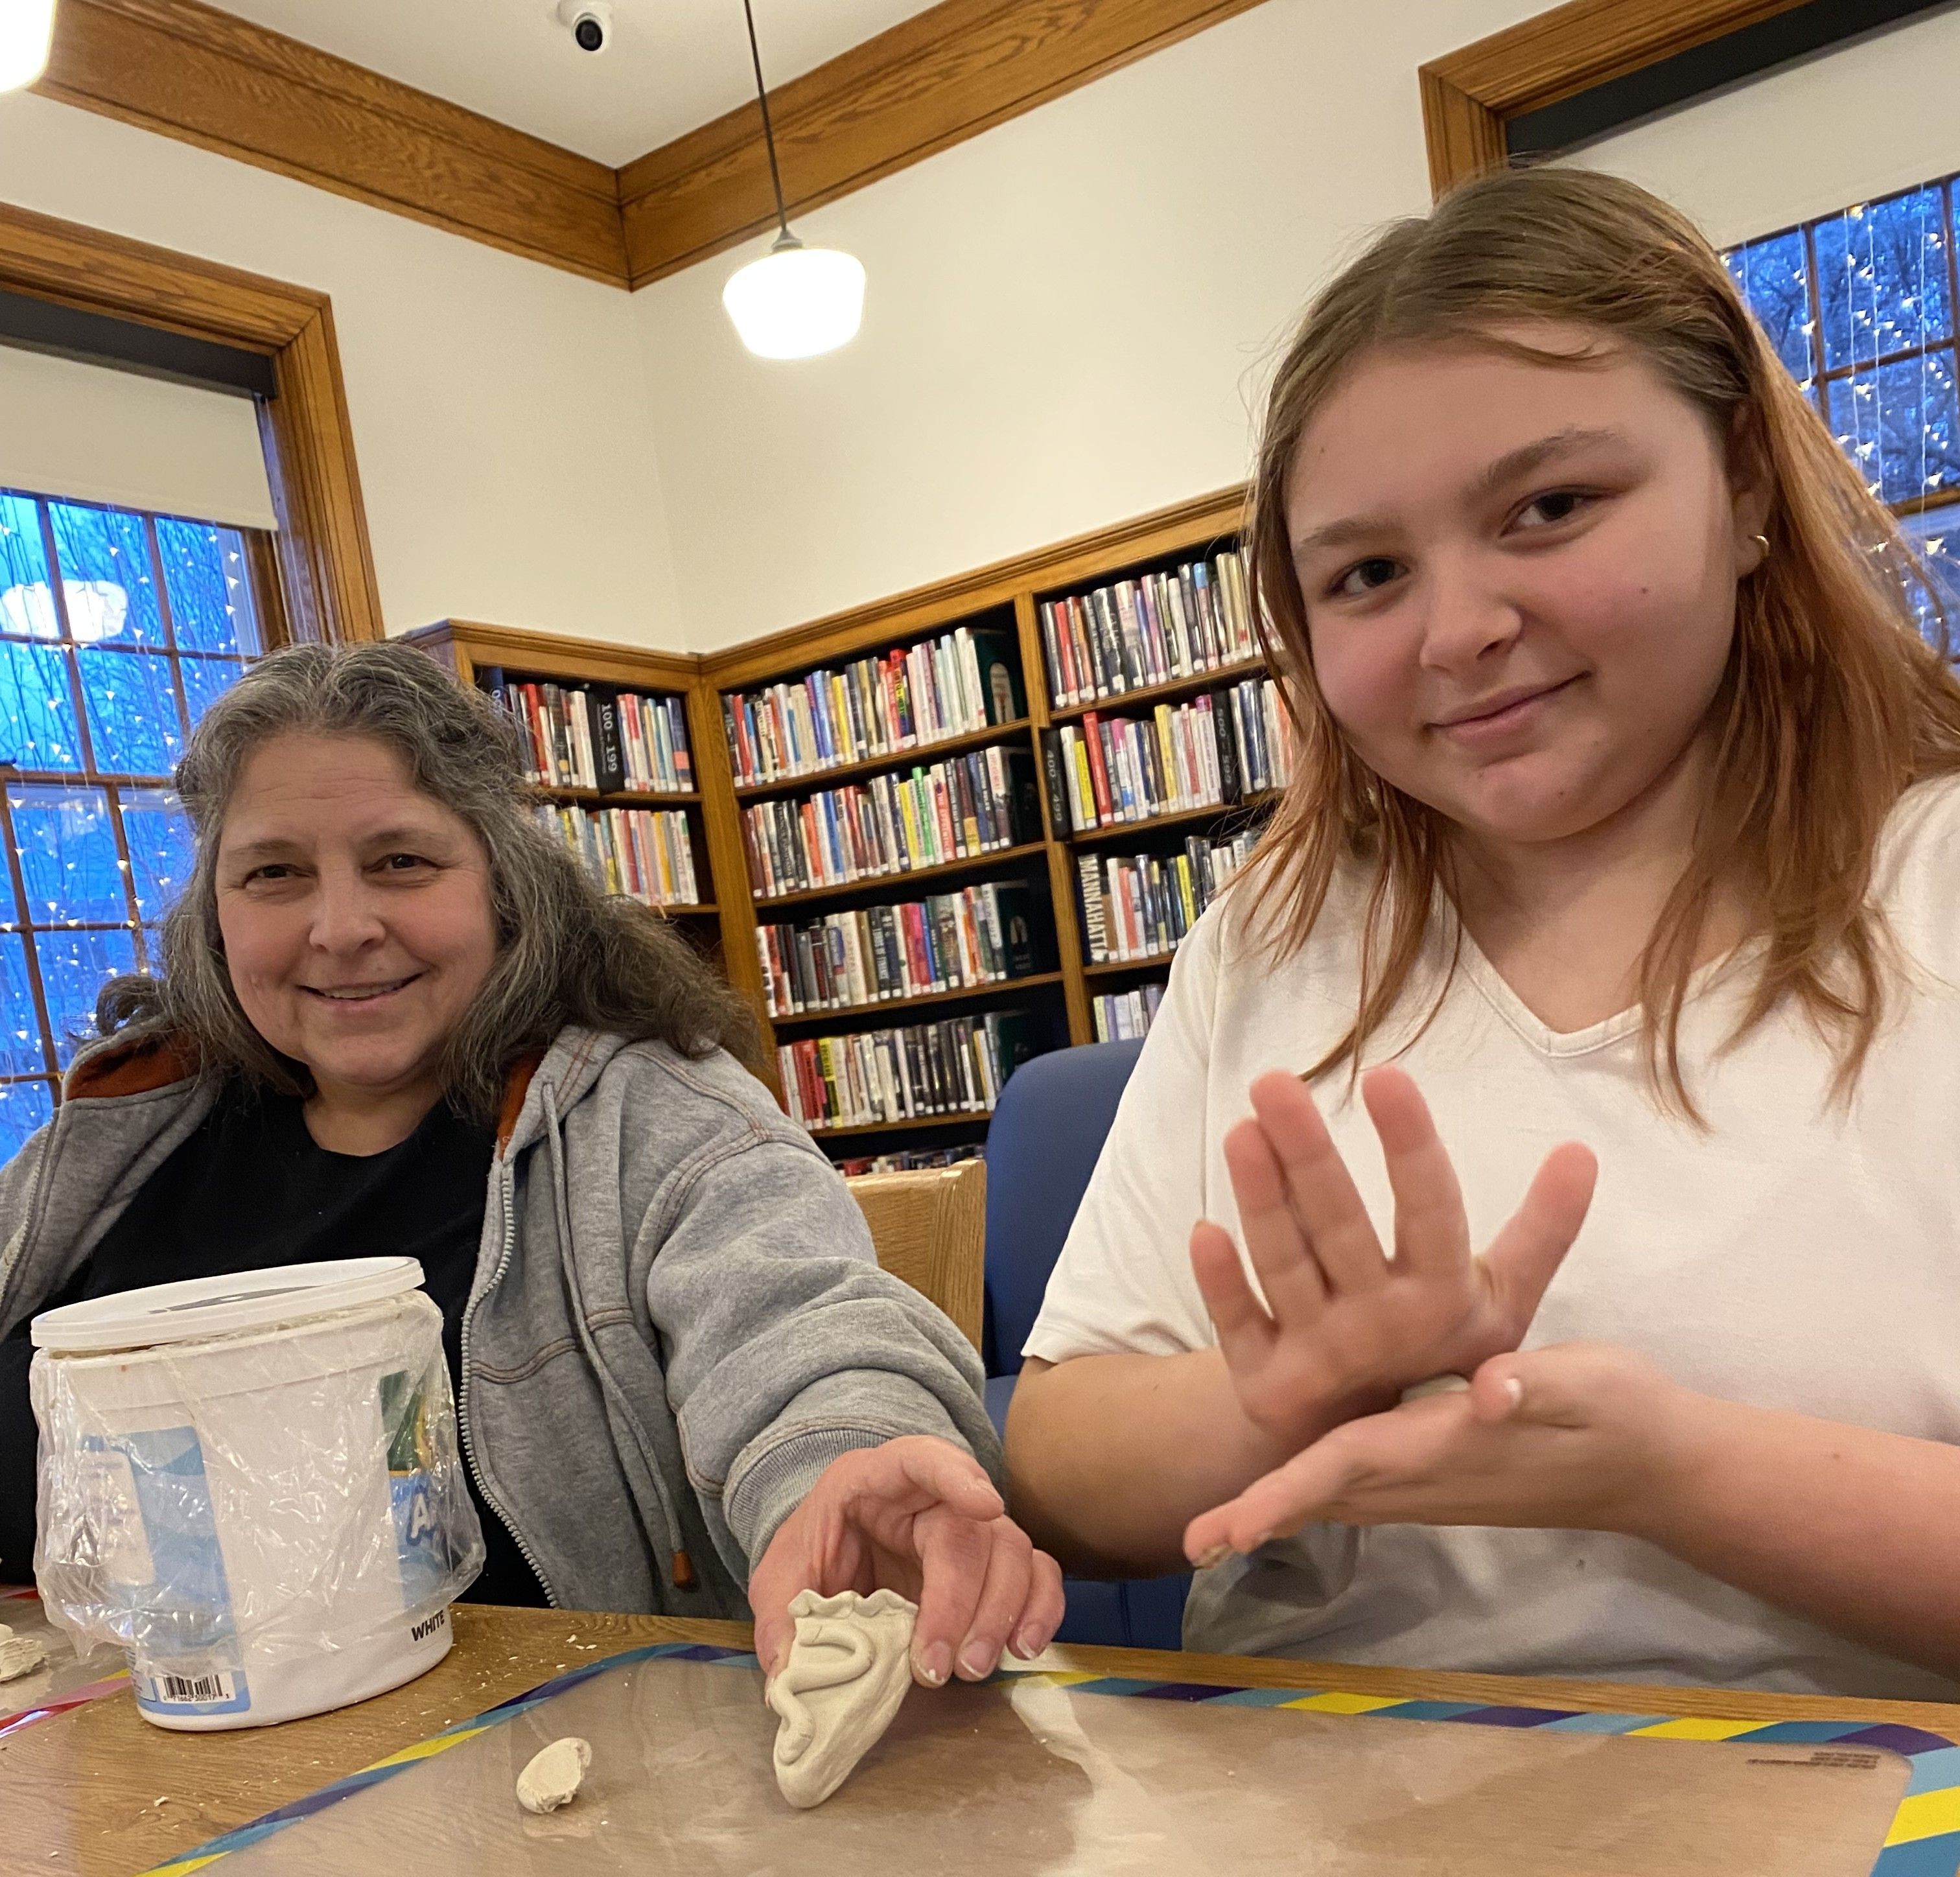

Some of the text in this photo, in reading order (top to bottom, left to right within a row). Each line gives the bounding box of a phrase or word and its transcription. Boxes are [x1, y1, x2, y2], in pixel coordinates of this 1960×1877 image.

[601, 703, 612, 730] 100
[606, 745, 618, 772] 199
[1216, 708, 1226, 736] 500
[1222, 754, 1232, 784] 599
[1047, 749, 1056, 778] 400
[1053, 793, 1063, 822] 499
[411, 1609, 445, 1642] WHITE
